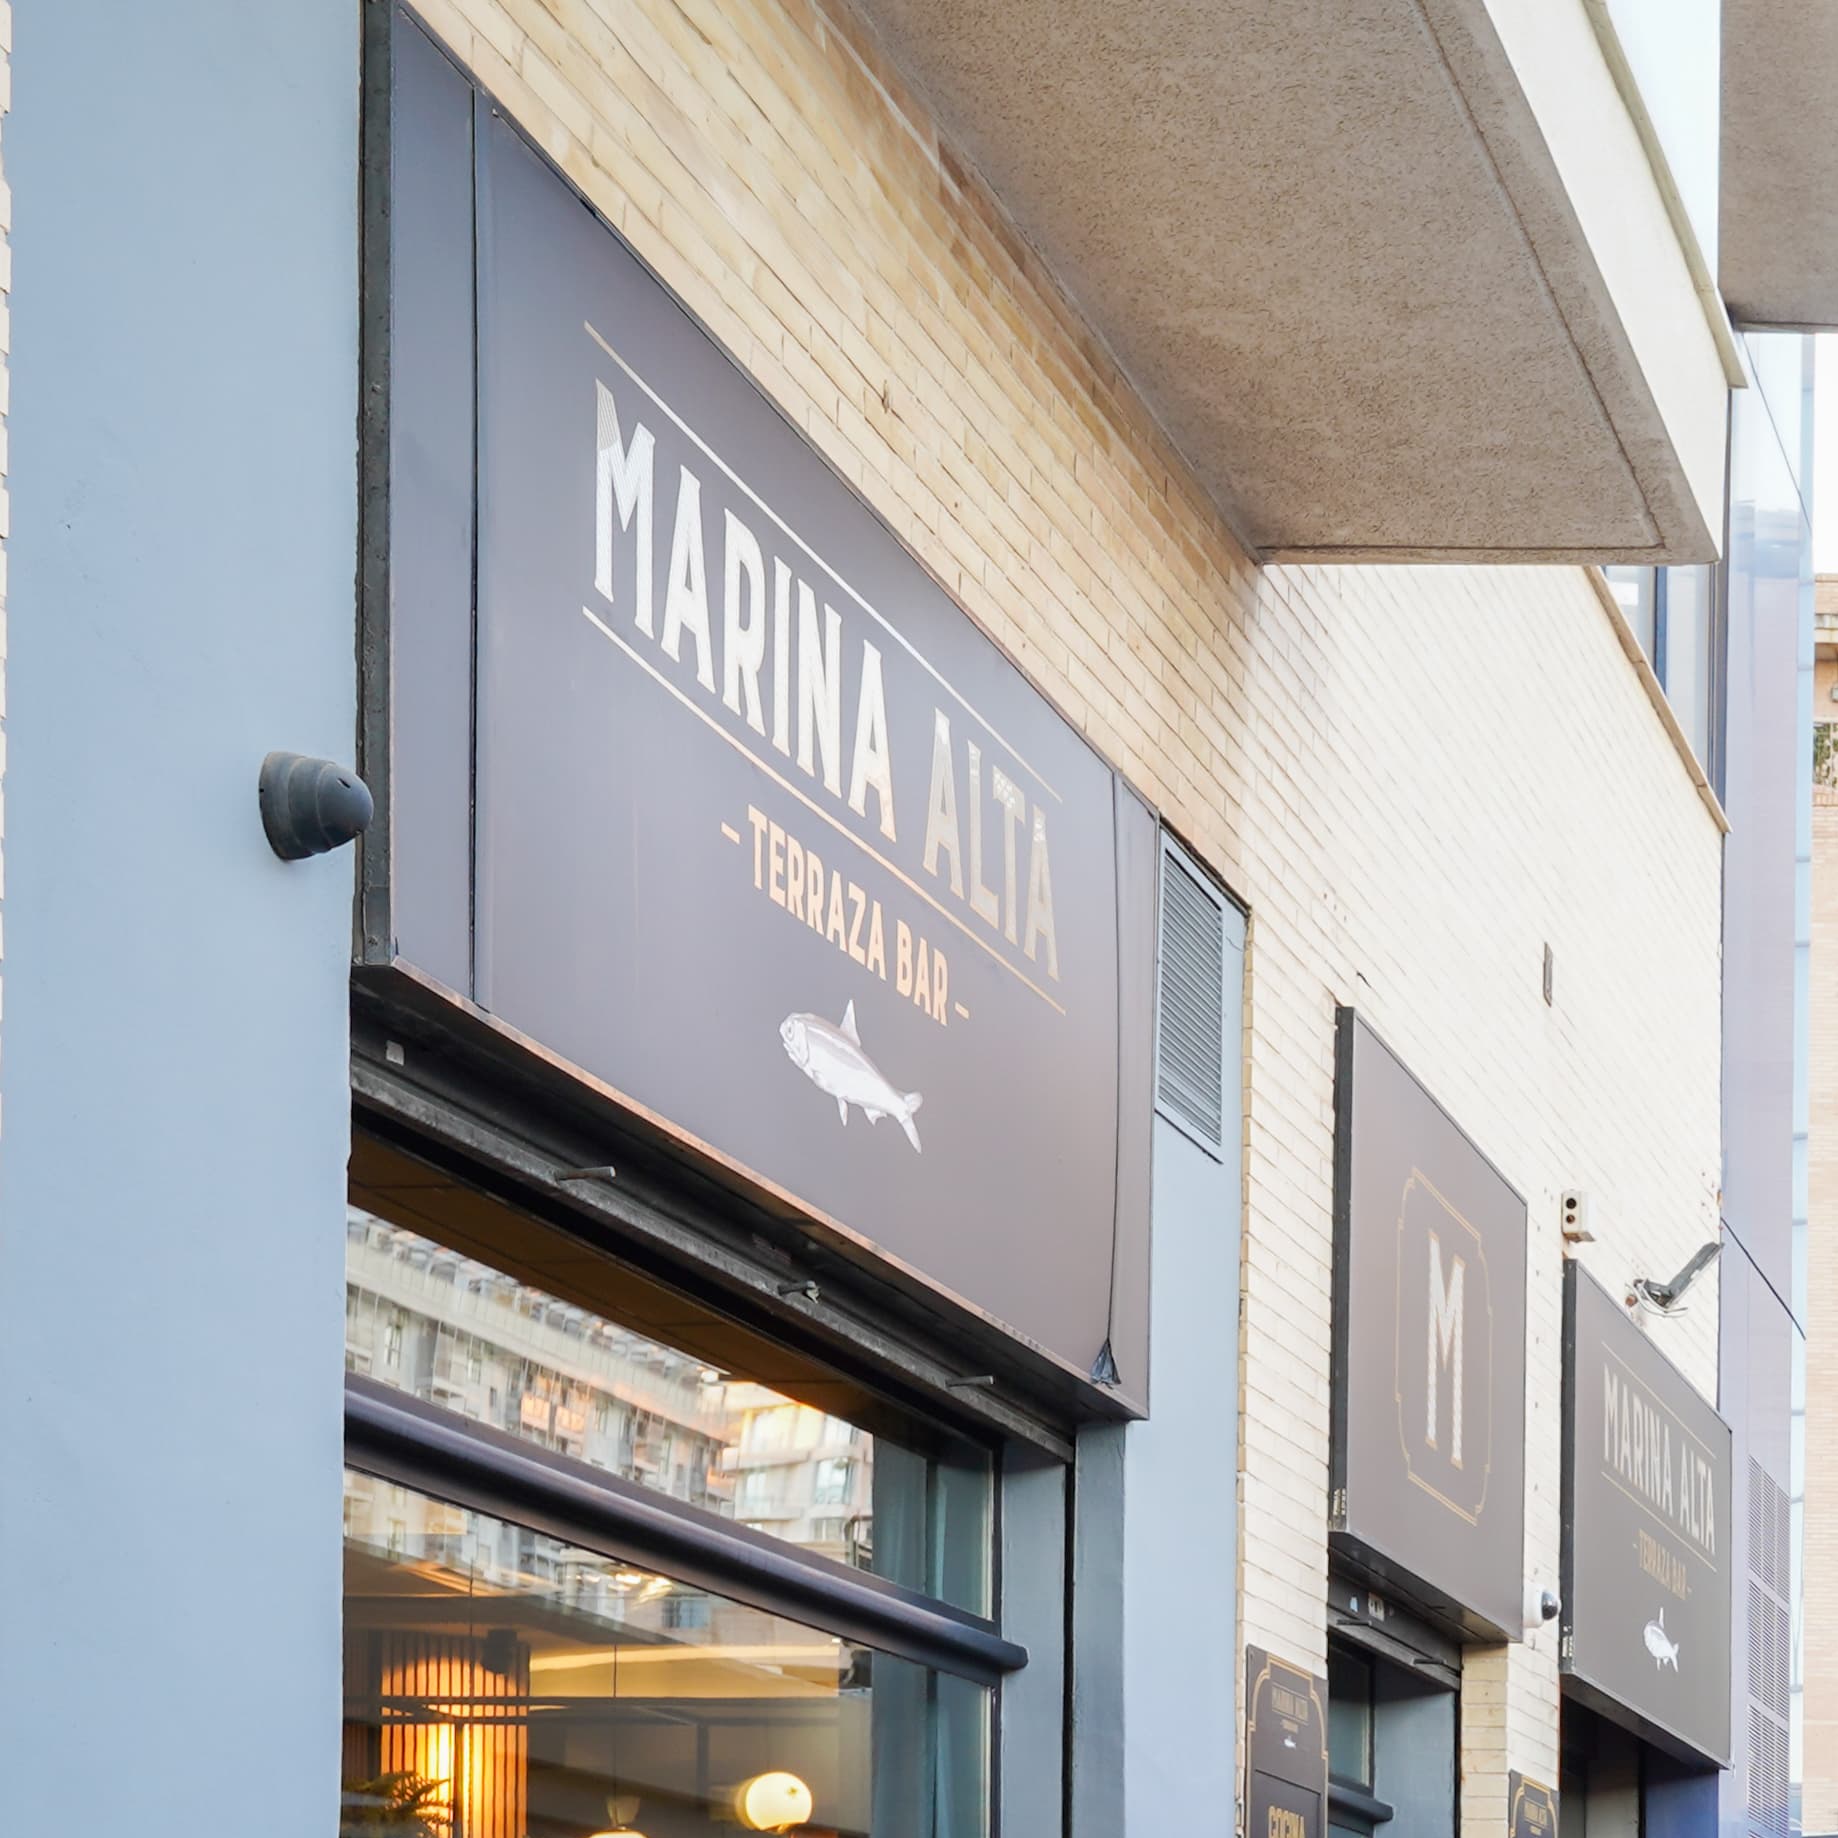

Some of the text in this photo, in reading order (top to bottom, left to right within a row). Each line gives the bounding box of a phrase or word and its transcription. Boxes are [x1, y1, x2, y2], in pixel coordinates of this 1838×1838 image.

[594, 377, 1060, 982] MARINA ALTA
[747, 804, 950, 1027] TERRAZA BAR
[1426, 1230, 1466, 1470] M
[1603, 1361, 1716, 1555] MARINA ALTA
